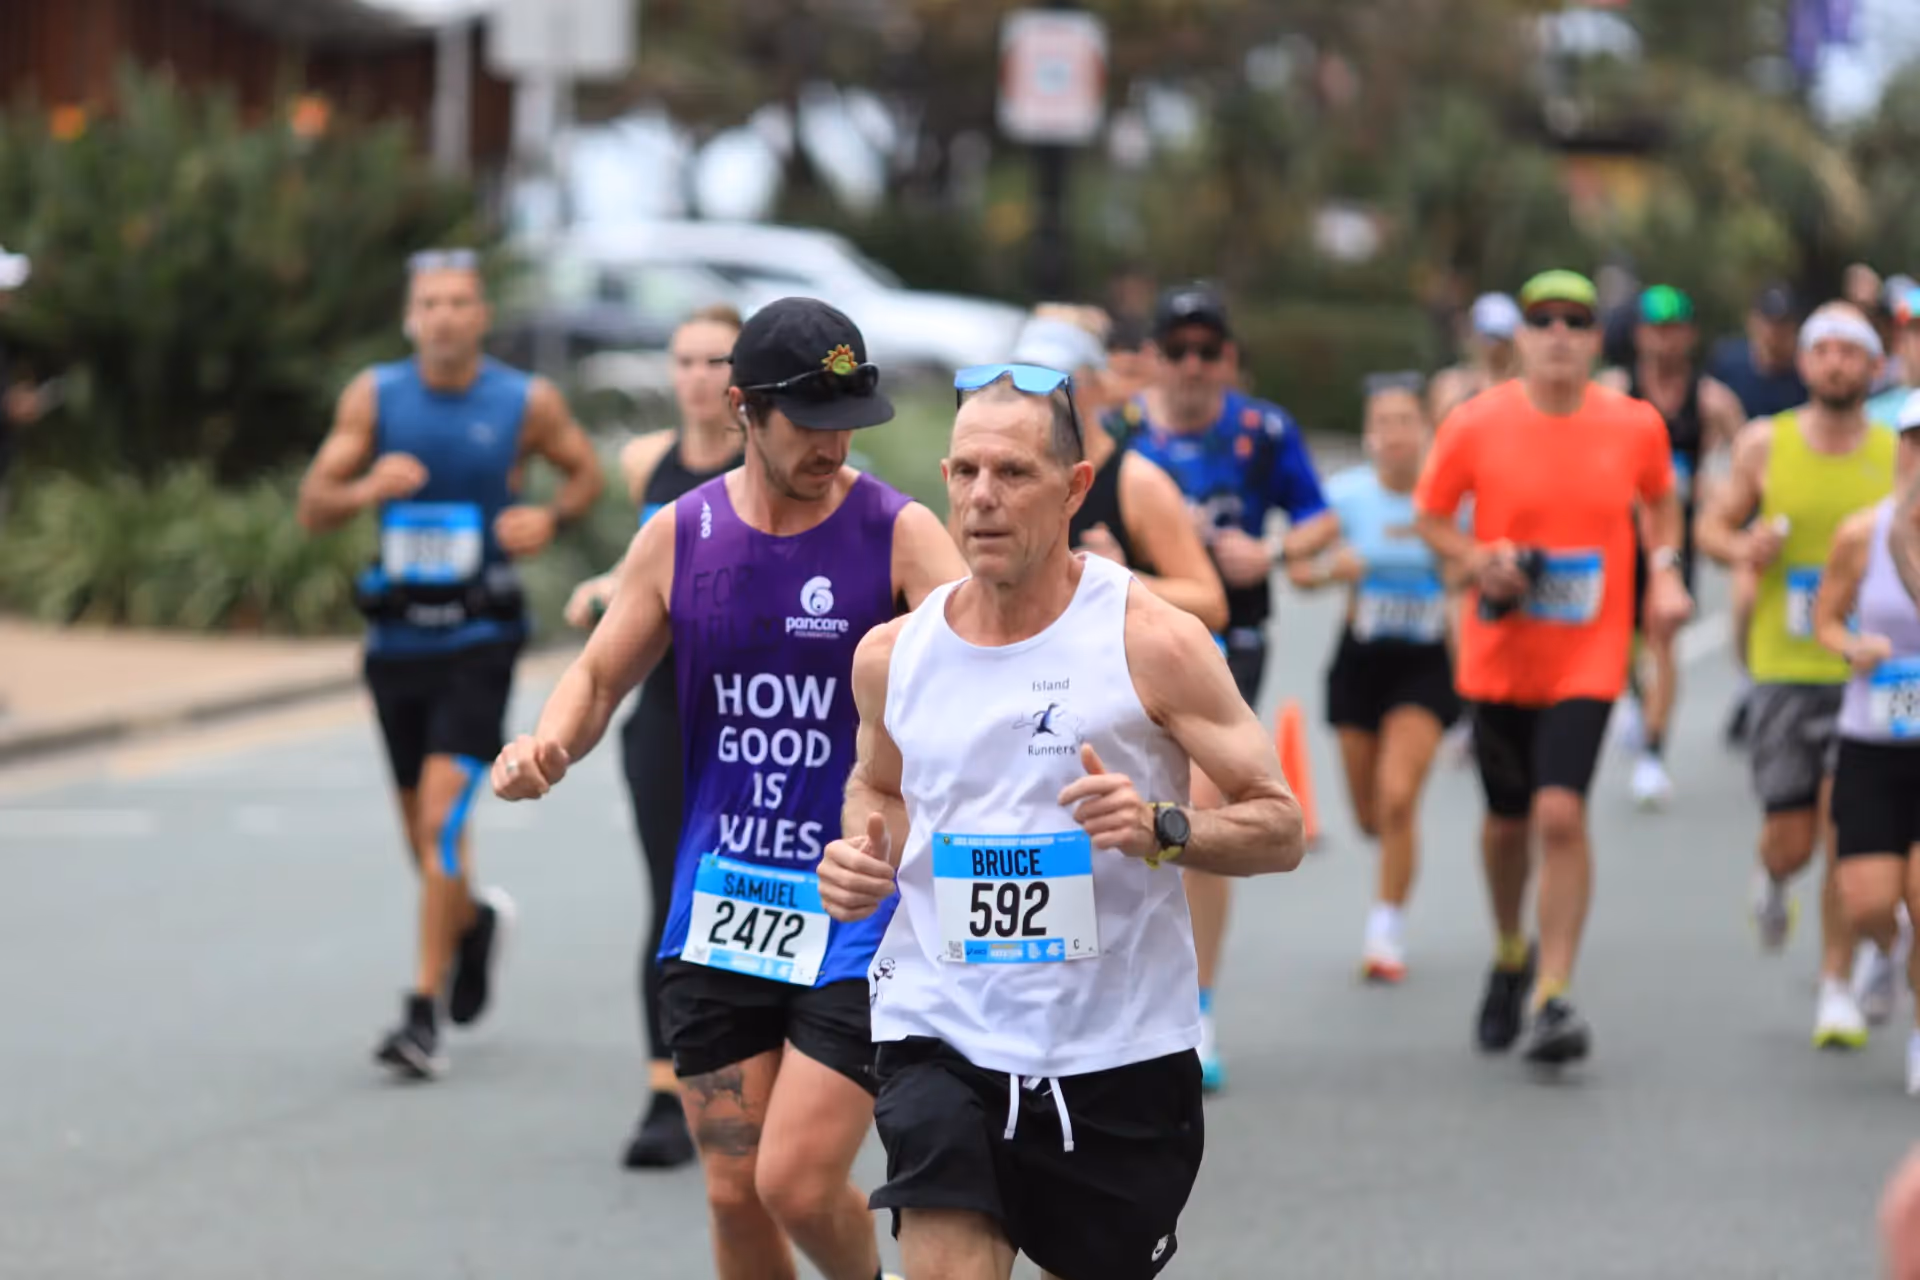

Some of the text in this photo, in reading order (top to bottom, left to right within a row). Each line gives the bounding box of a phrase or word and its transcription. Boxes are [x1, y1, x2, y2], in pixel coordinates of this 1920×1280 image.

[785, 617, 849, 633] pancare
[713, 673, 837, 720] HOW
[1032, 677, 1070, 692] Island
[718, 725, 831, 768] GOOD
[1028, 744, 1076, 757] Runners
[753, 772, 787, 809] IS
[972, 849, 1043, 877] BRUCE
[723, 873, 798, 908] SAMUEL
[970, 881, 1050, 938] 592
[708, 901, 805, 959] 2472
